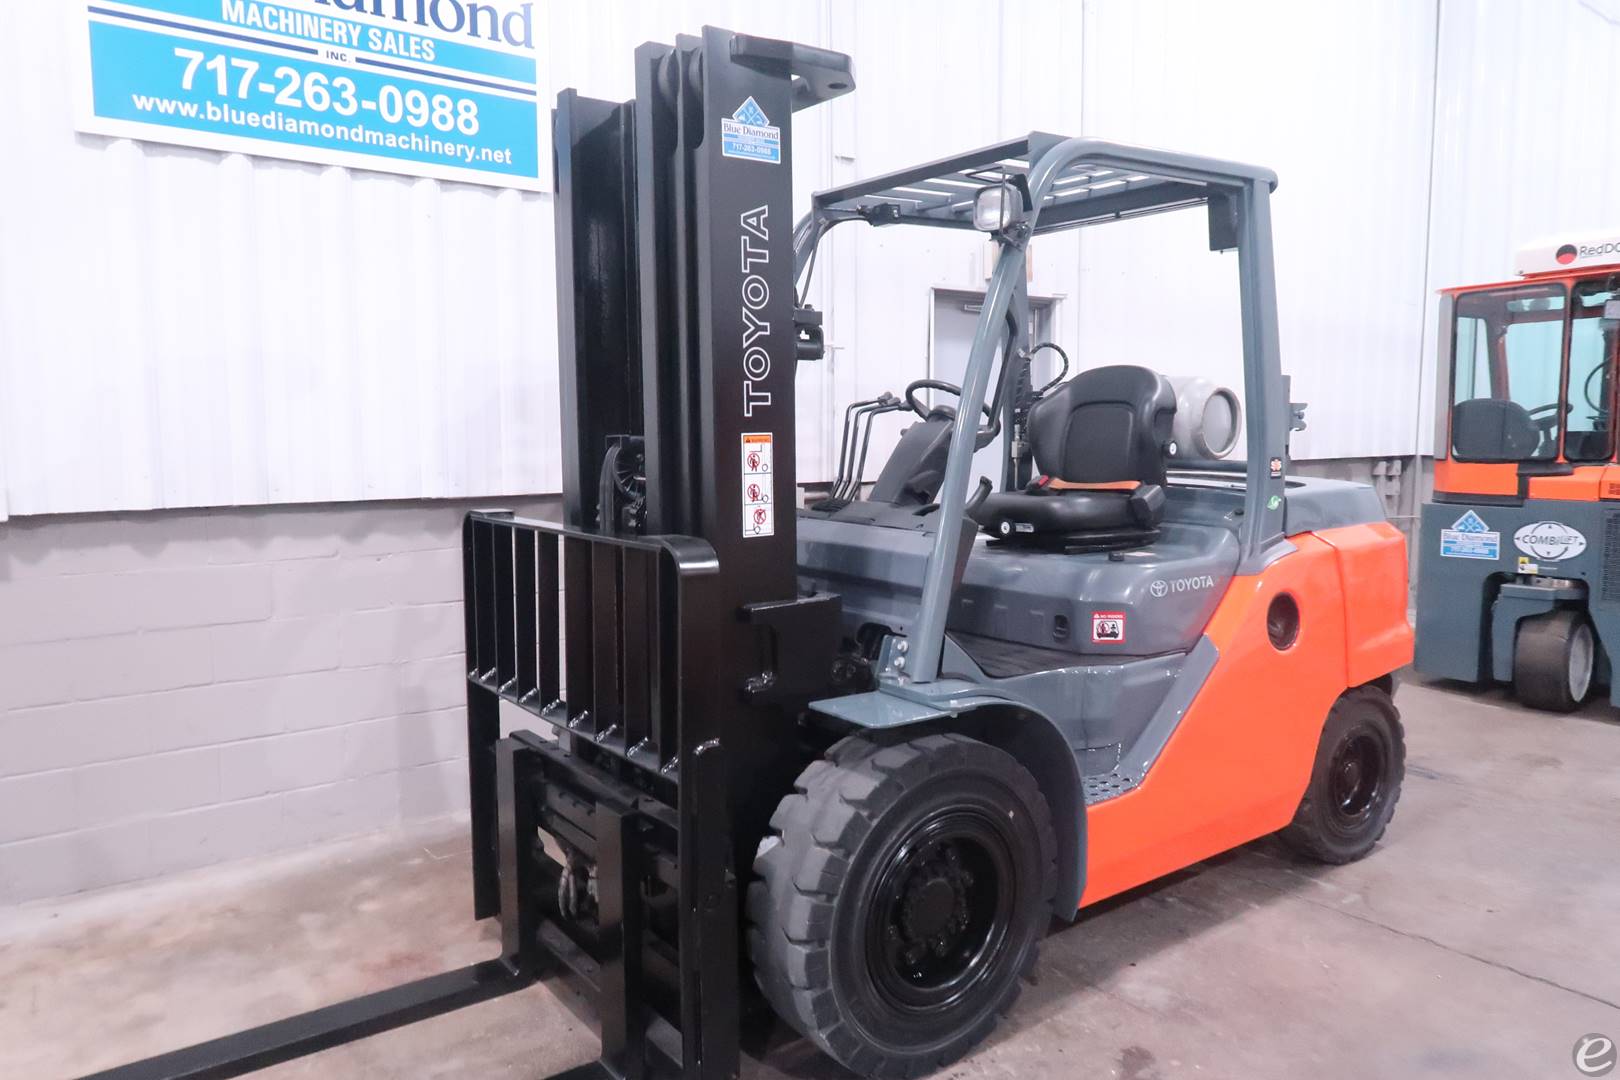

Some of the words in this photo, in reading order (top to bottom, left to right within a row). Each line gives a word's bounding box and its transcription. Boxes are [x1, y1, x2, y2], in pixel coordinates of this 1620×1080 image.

[221, 0, 362, 48] MACHINERY
[368, 25, 436, 62] SALES
[314, 0, 534, 49] mond
[174, 47, 480, 136] 717-263-0988
[132, 92, 513, 165] www.bluediamondmachinery.net
[723, 123, 741, 134] Blue
[741, 204, 771, 416] TOYOTA
[1171, 576, 1214, 592] TOYOTA
